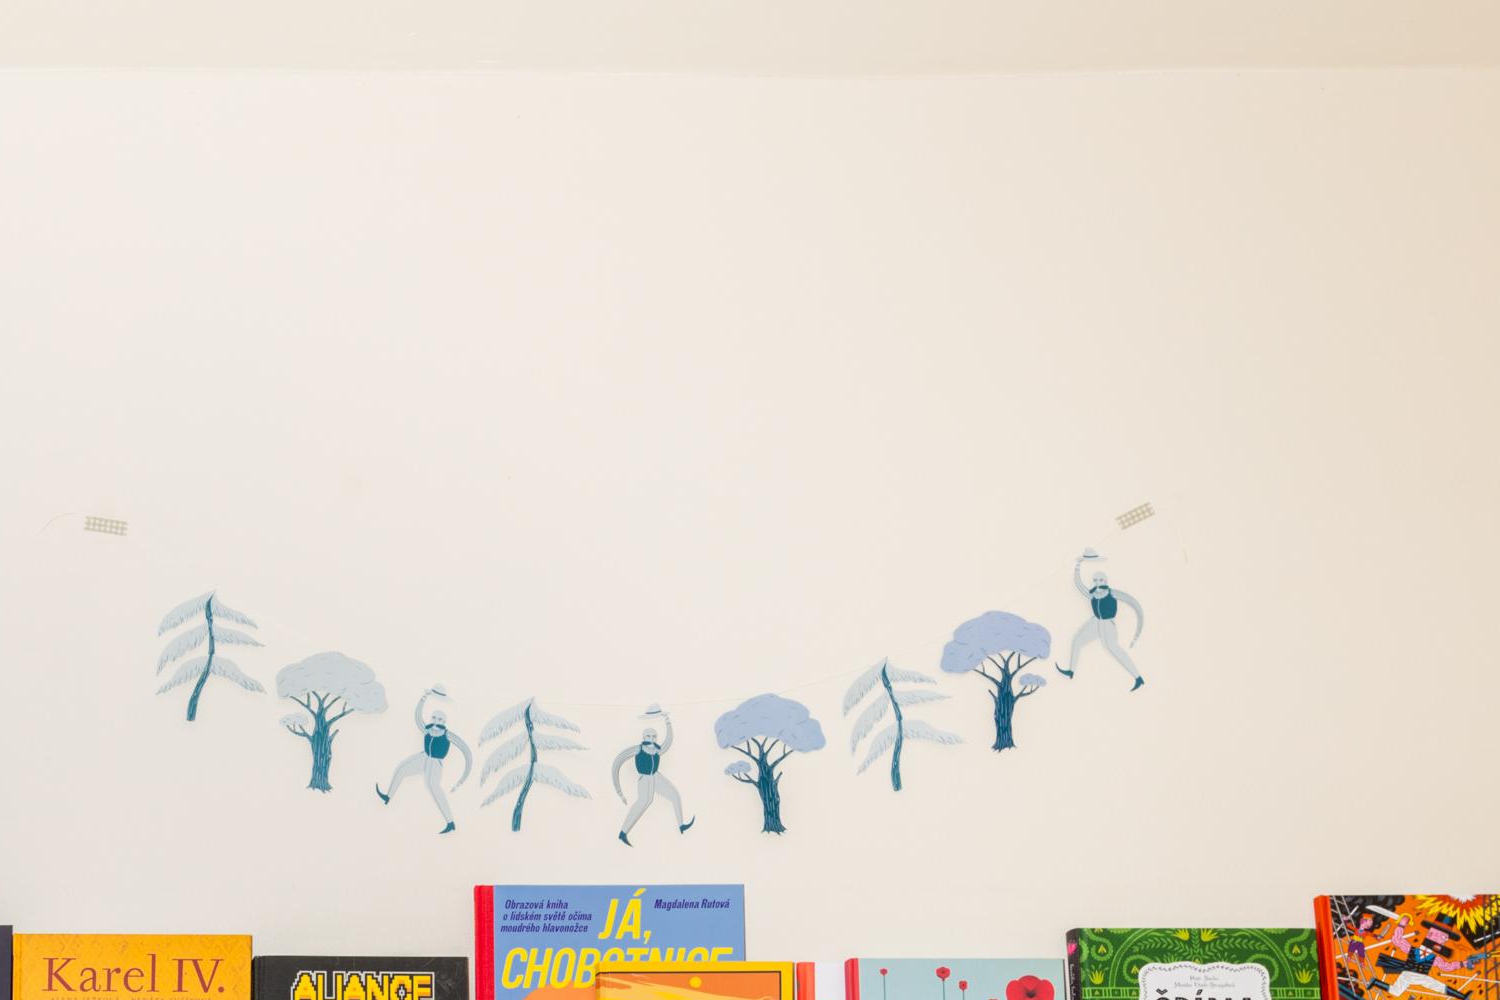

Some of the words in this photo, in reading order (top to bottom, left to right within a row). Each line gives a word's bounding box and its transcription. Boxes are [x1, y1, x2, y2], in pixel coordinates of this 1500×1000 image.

[505, 900, 544, 909] Obrazová
[546, 900, 568, 909] kniha
[654, 899, 699, 910] Magdalena
[701, 899, 730, 909] Rutová
[510, 912, 541, 921] lidském
[543, 912, 566, 921] světě
[568, 912, 592, 922] očima
[598, 888, 652, 944] JÁ,
[501, 922, 540, 933] moudrého
[542, 923, 588, 933] hlavonožce
[42, 954, 157, 993] Karel
[172, 958, 225, 993] IV.
